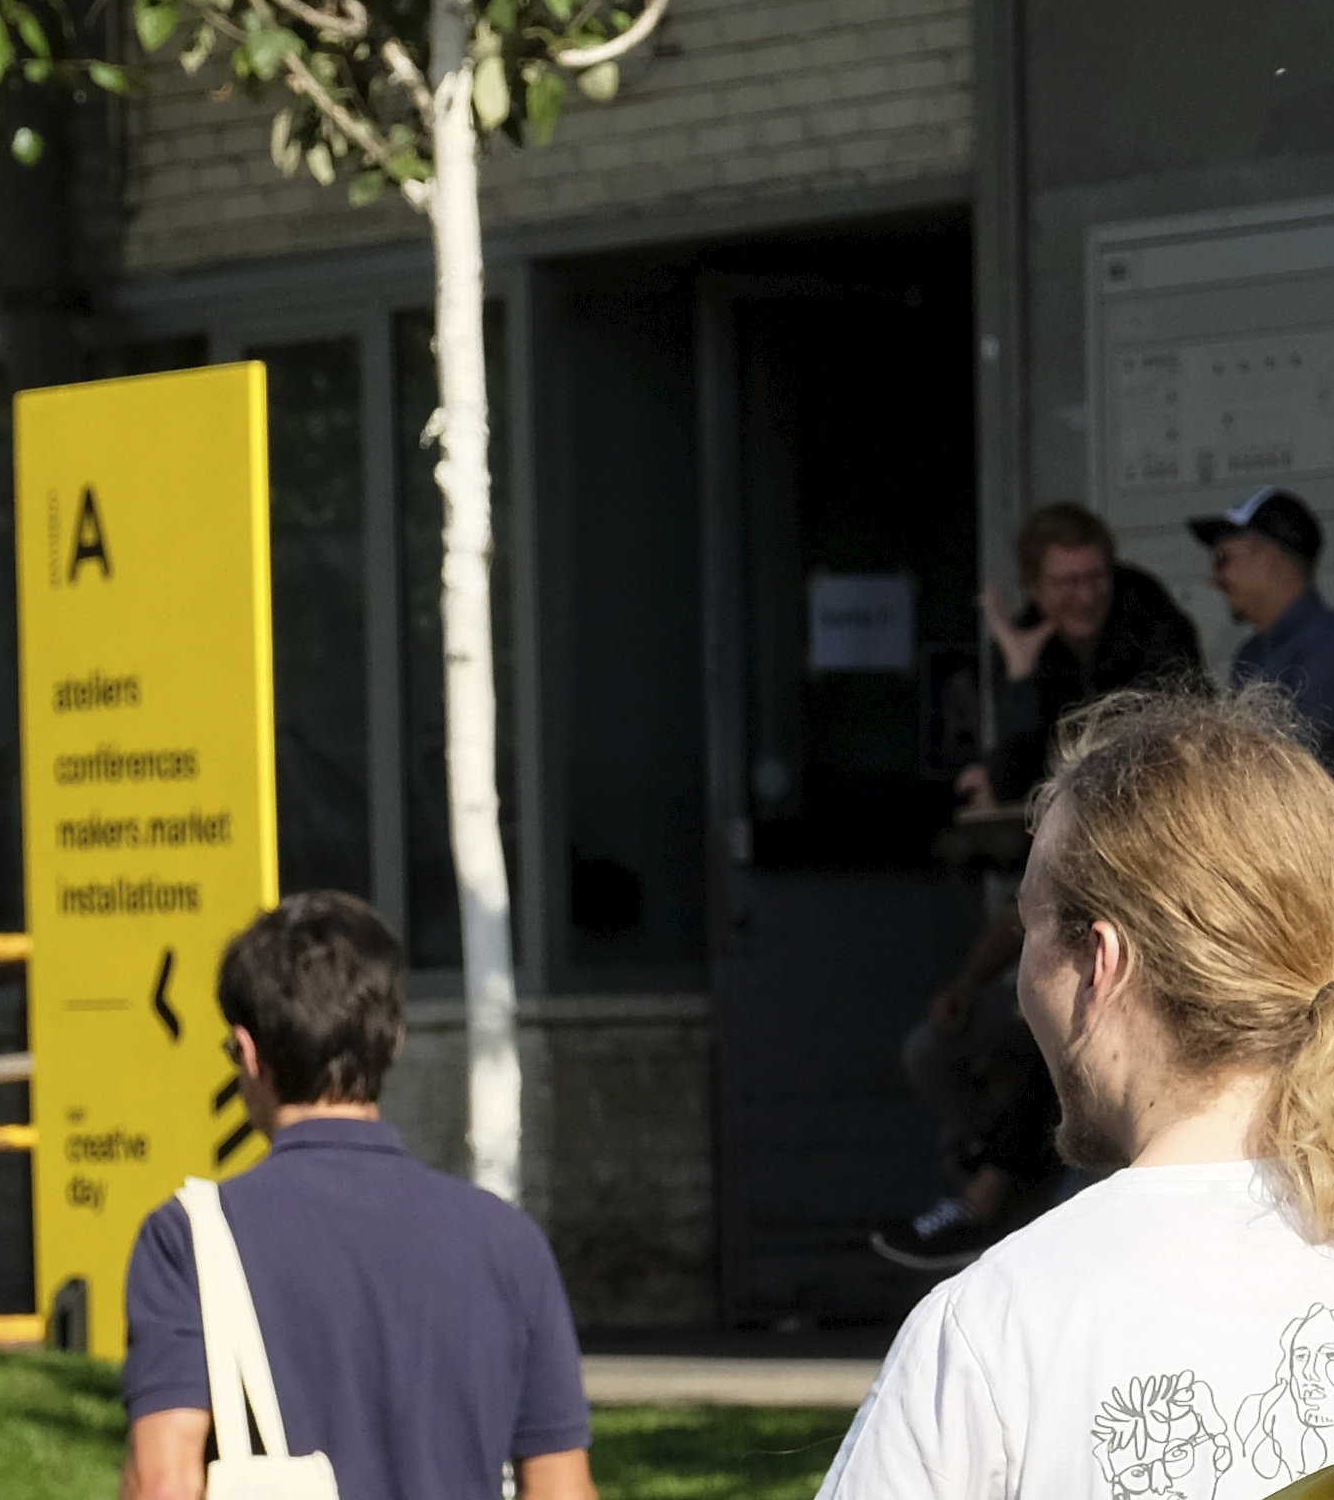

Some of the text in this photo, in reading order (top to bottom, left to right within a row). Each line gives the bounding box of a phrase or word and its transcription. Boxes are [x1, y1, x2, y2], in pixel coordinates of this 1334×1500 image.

[67, 482, 114, 584] A
[53, 669, 142, 715] ateliers
[58, 874, 202, 915] installations
[65, 1127, 151, 1164] creative
[65, 1174, 107, 1215] day
